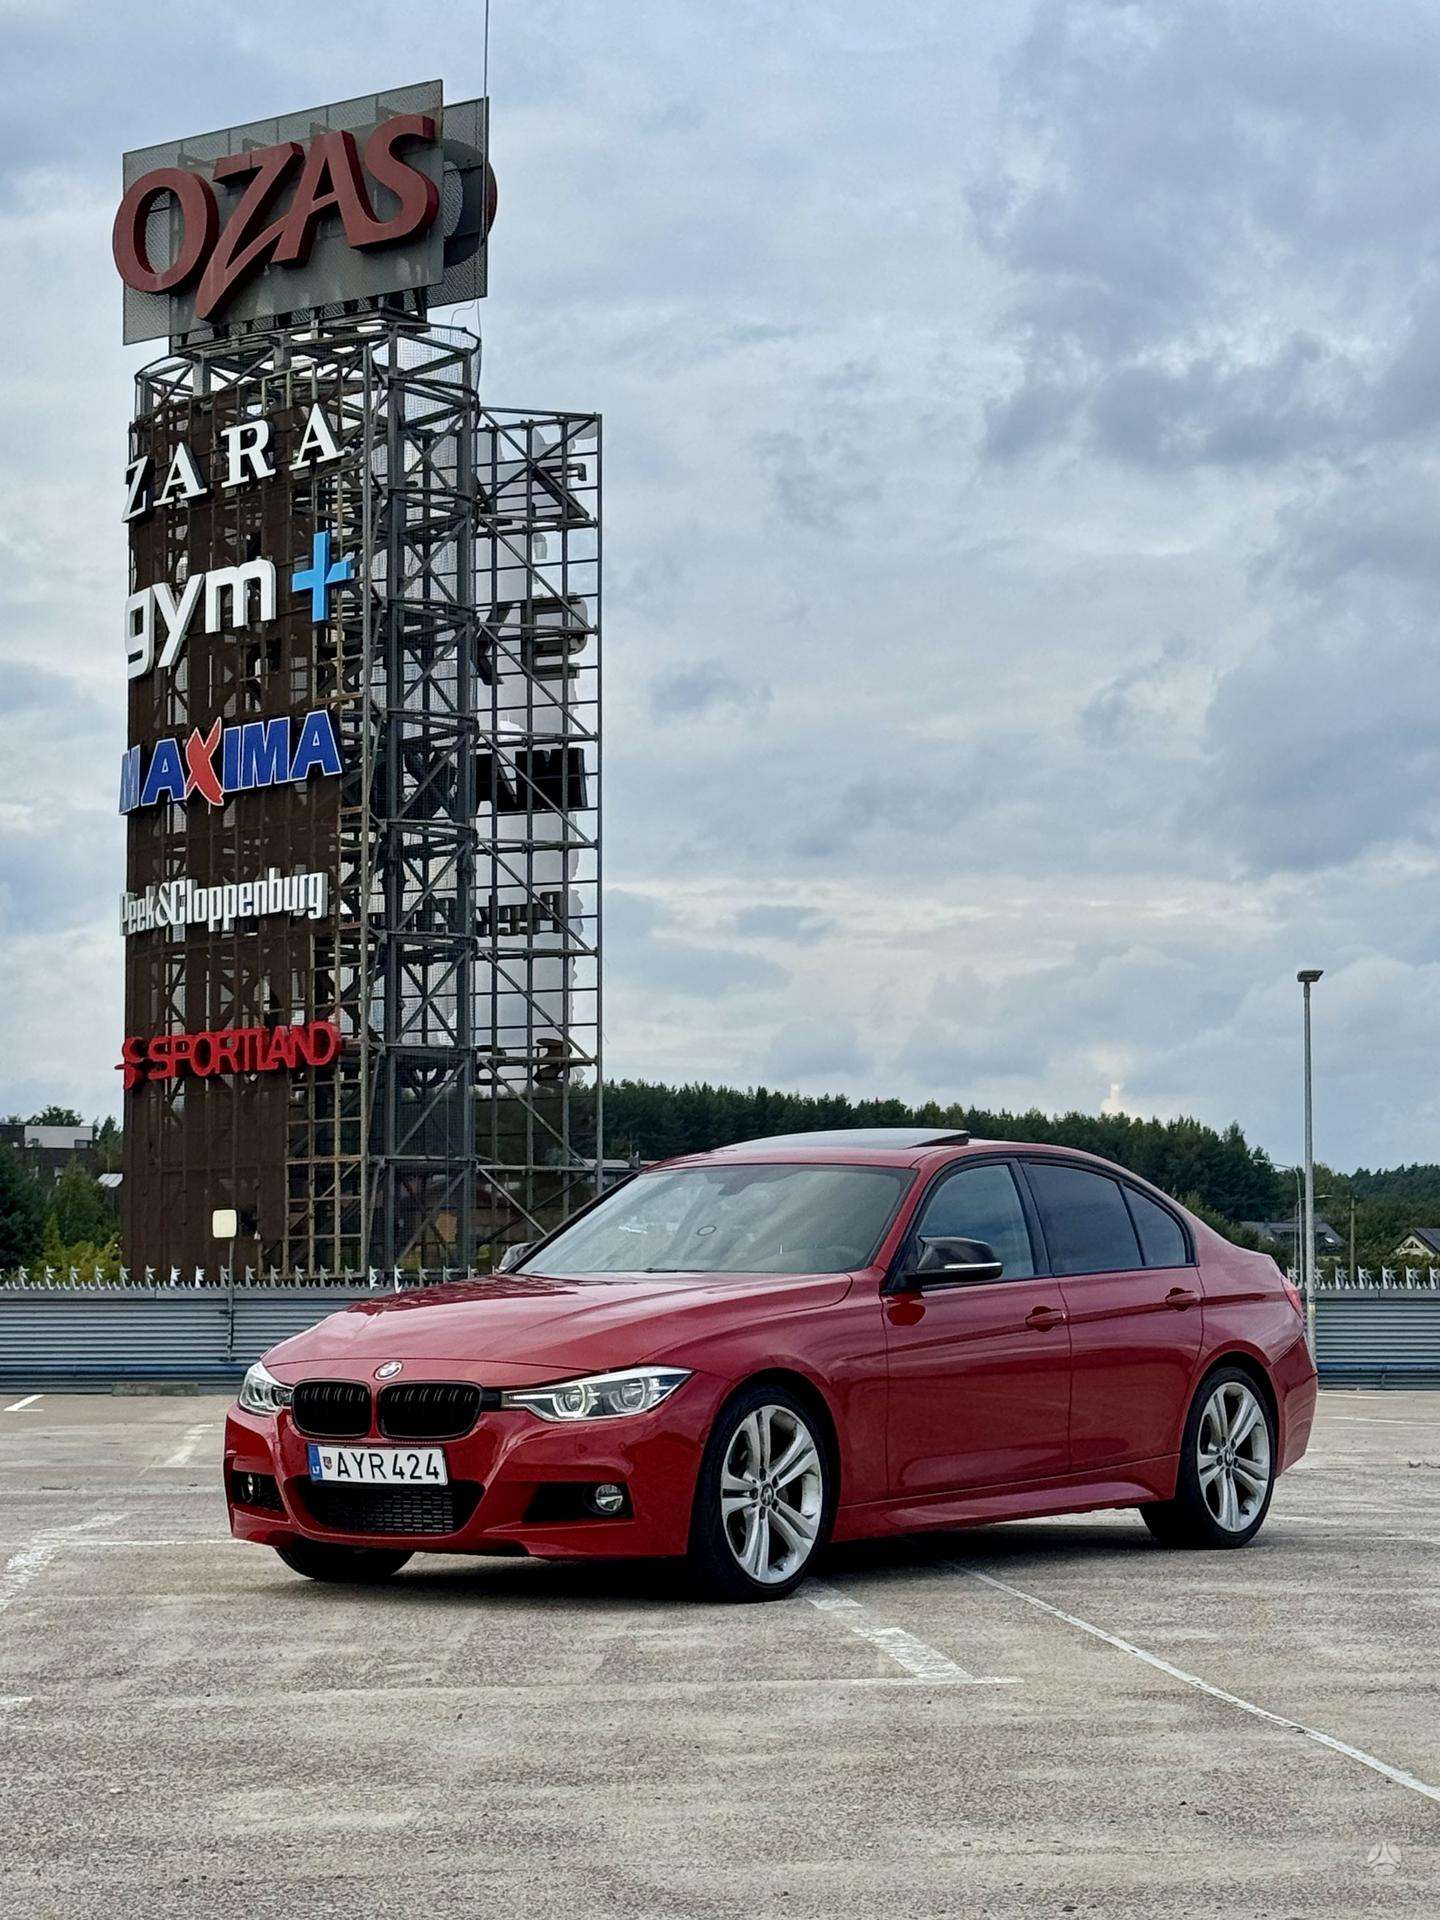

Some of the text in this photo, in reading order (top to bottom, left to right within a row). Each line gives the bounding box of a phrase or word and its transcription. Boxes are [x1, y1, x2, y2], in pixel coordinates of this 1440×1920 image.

[112, 114, 439, 319] OZAS
[122, 402, 346, 523] ZARA
[118, 709, 342, 816] MAXIMA
[148, 1020, 341, 1080] SPORTLAND
